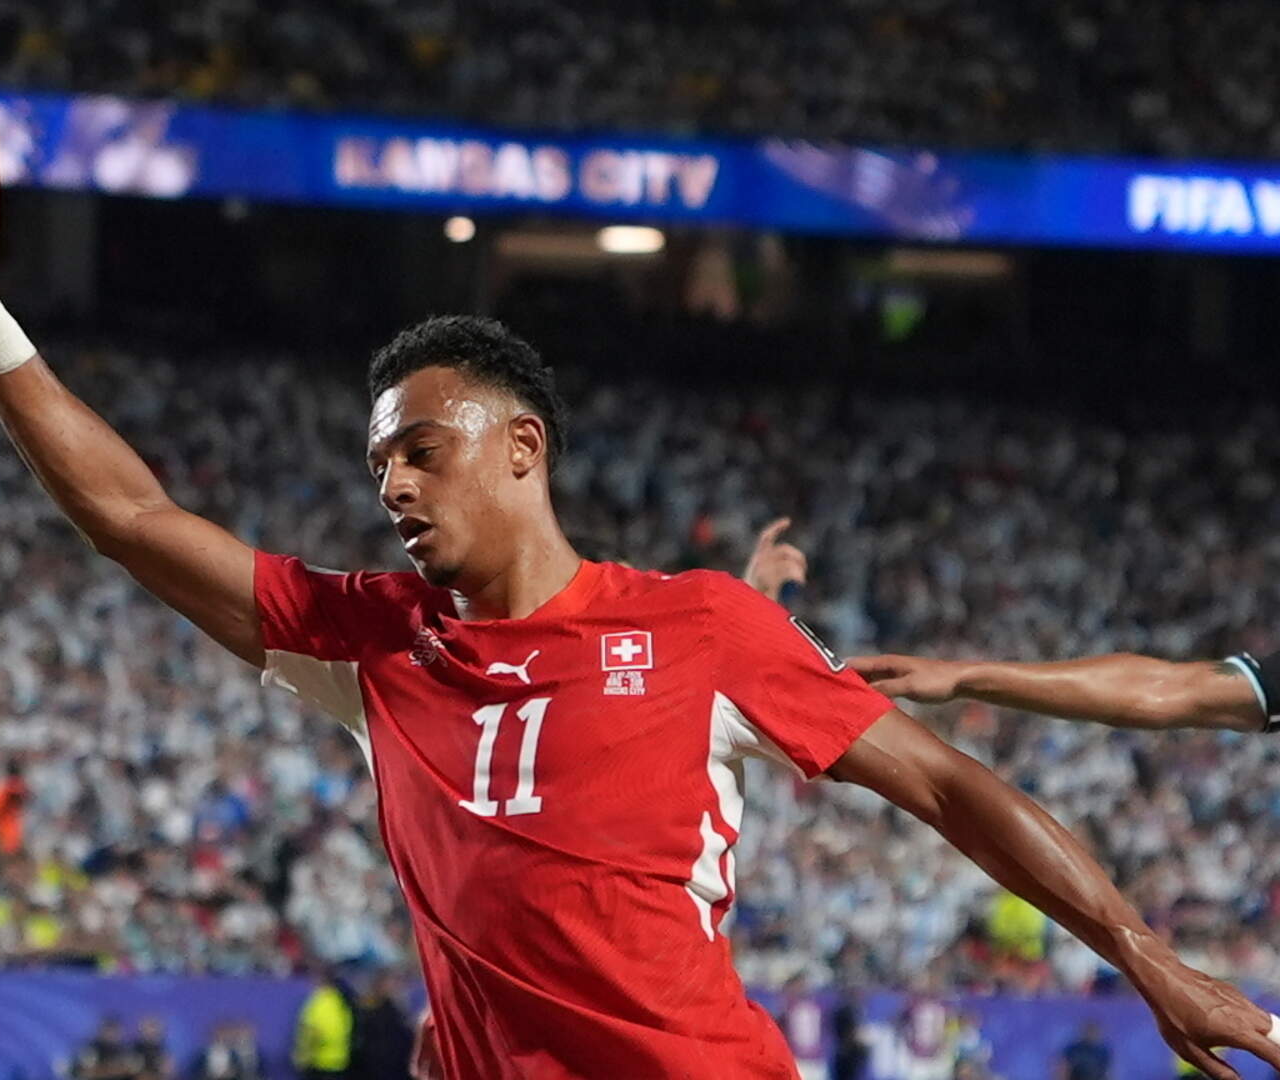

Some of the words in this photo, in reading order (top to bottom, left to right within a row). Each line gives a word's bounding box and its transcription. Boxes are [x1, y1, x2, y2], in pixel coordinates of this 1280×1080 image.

[334, 135, 570, 201] KANSAS
[578, 149, 720, 209] CITY
[1129, 174, 1253, 234] FIFA
[459, 697, 552, 818] 11
